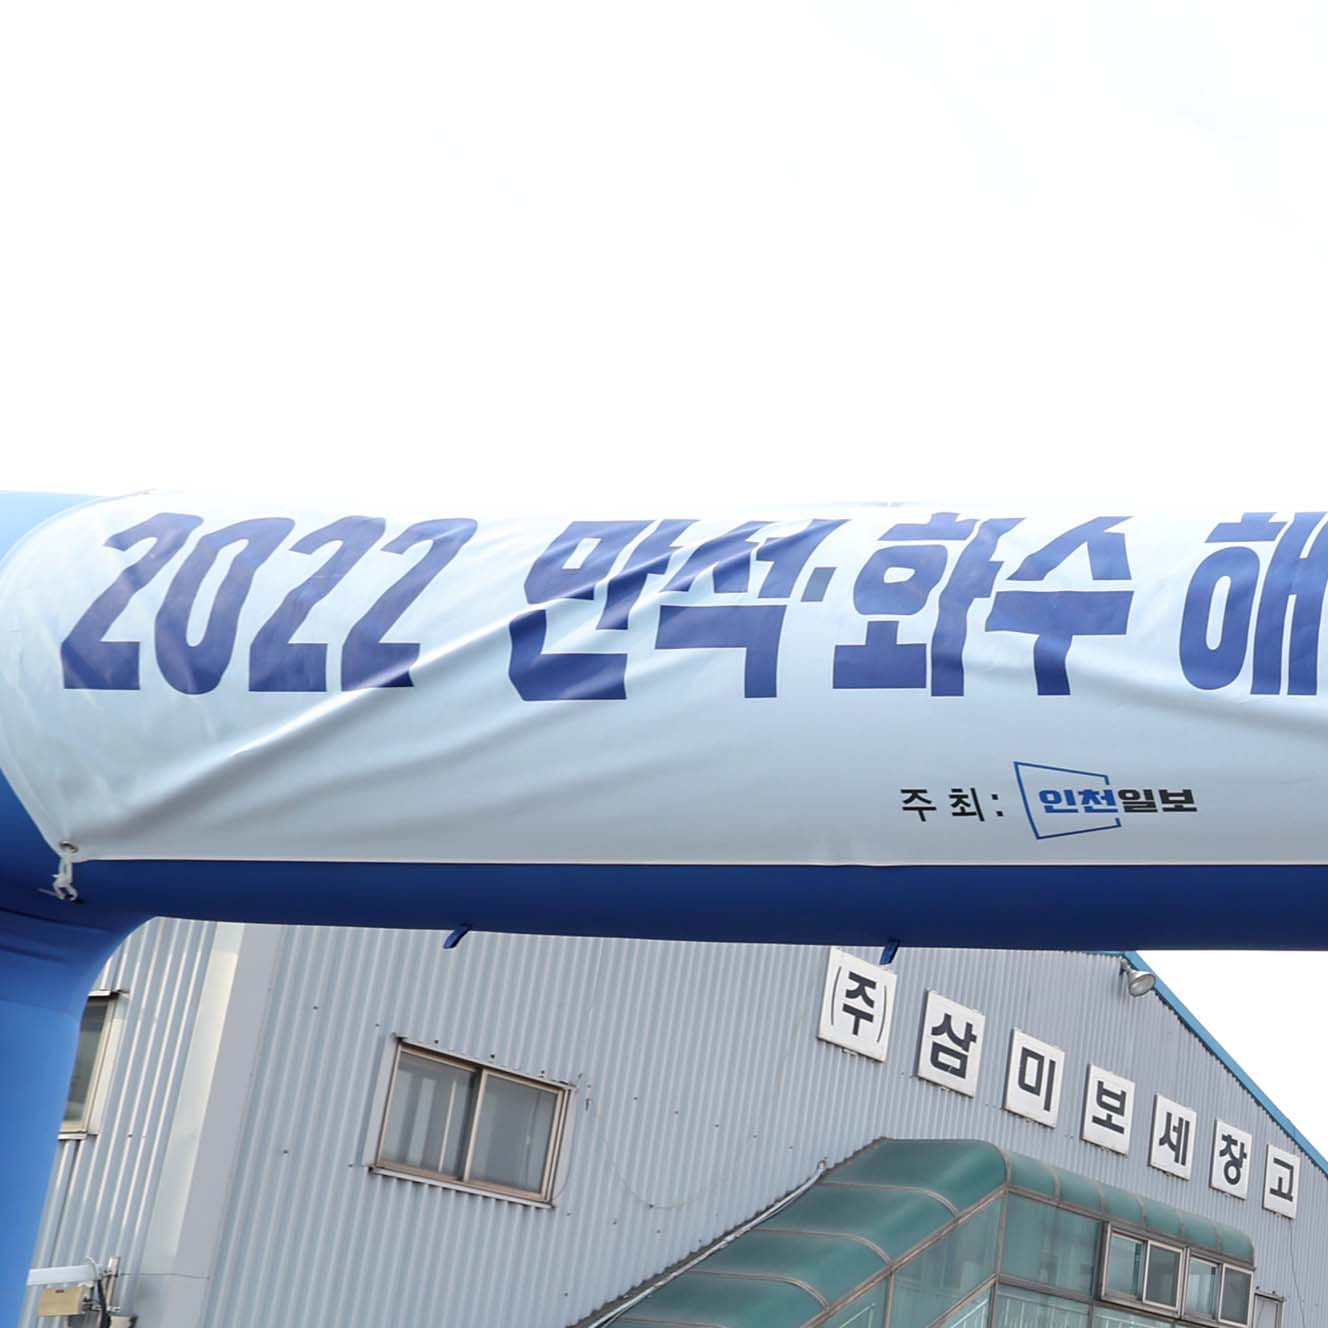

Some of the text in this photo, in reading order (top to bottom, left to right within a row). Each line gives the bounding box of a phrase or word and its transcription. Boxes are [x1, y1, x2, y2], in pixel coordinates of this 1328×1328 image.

[61, 511, 479, 695] 2022
[508, 512, 1134, 701] 만석·화수
[1037, 787, 1198, 815] 인천일보
